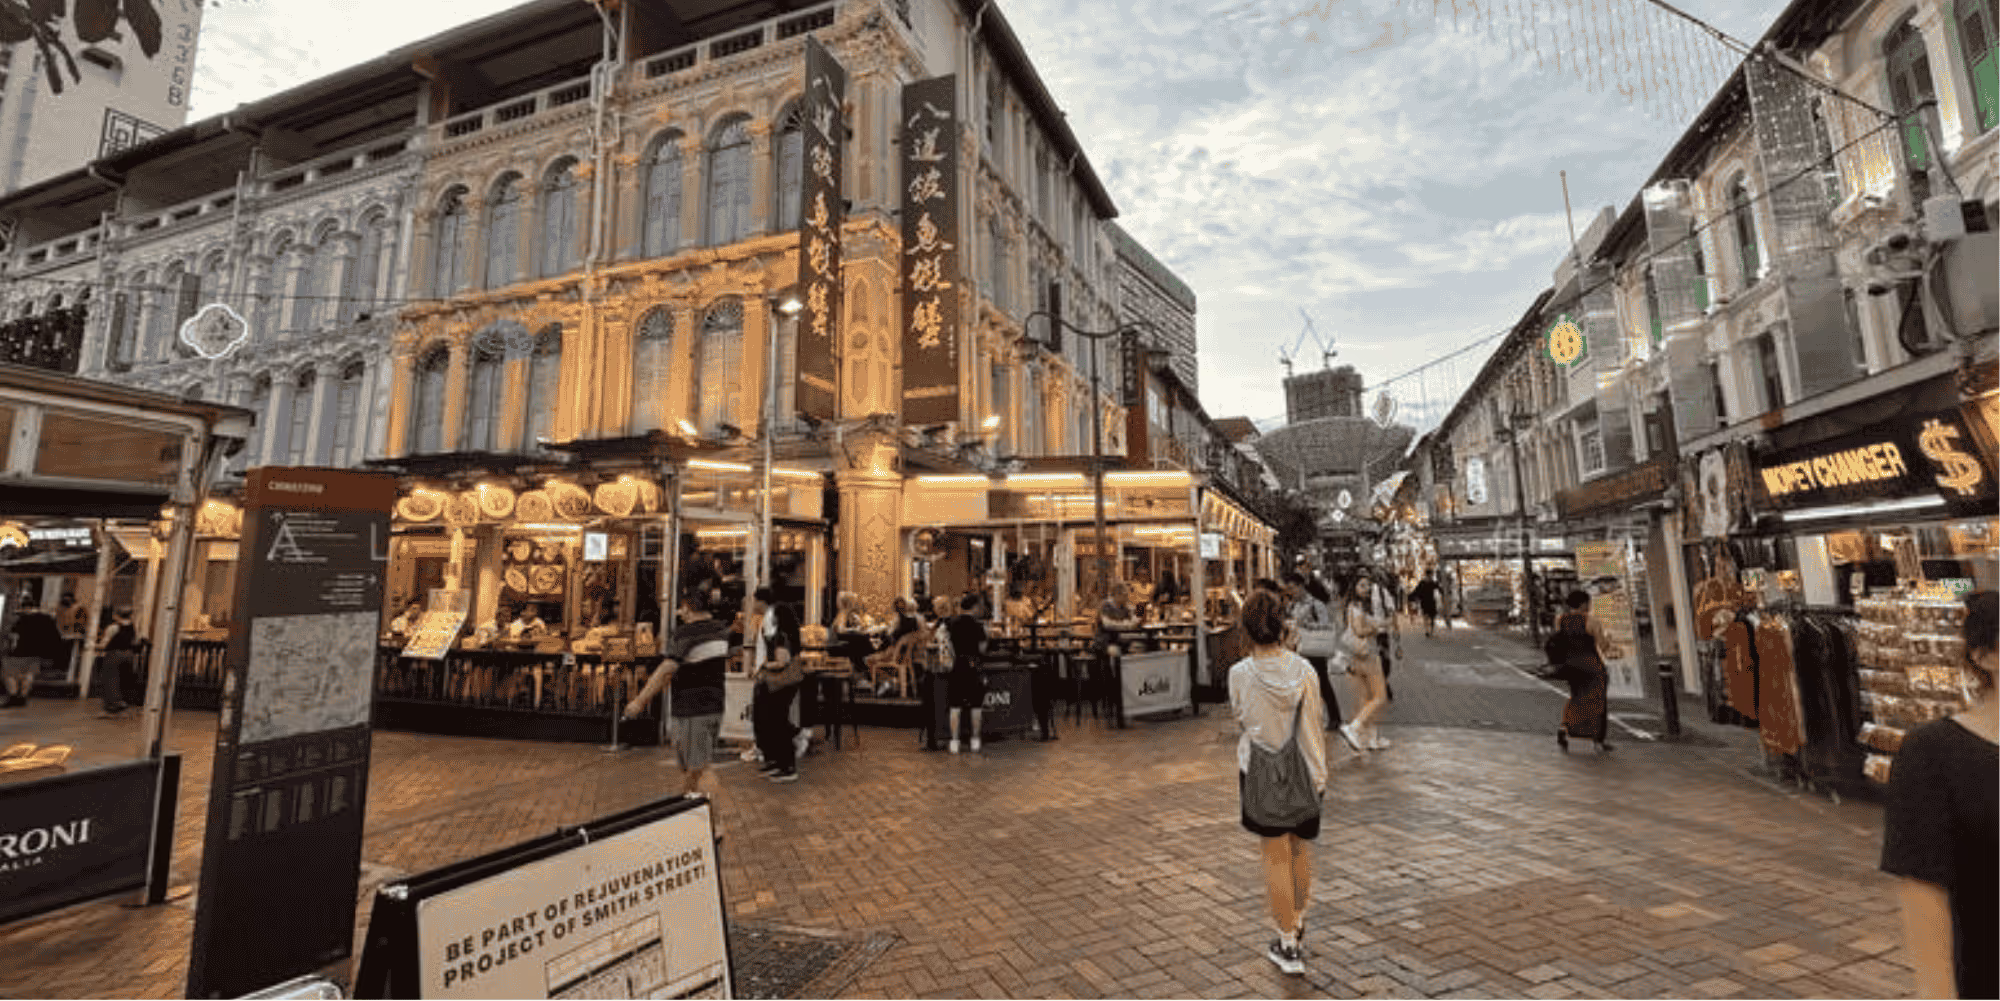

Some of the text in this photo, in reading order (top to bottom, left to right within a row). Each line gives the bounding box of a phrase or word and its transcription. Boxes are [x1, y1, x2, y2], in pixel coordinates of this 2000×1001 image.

[1812, 441, 1907, 488] CHANGER
[442, 863, 707, 989] PROJECT OF SMITH STREET!
[445, 846, 704, 963] BE PART OF REJUVENATION
